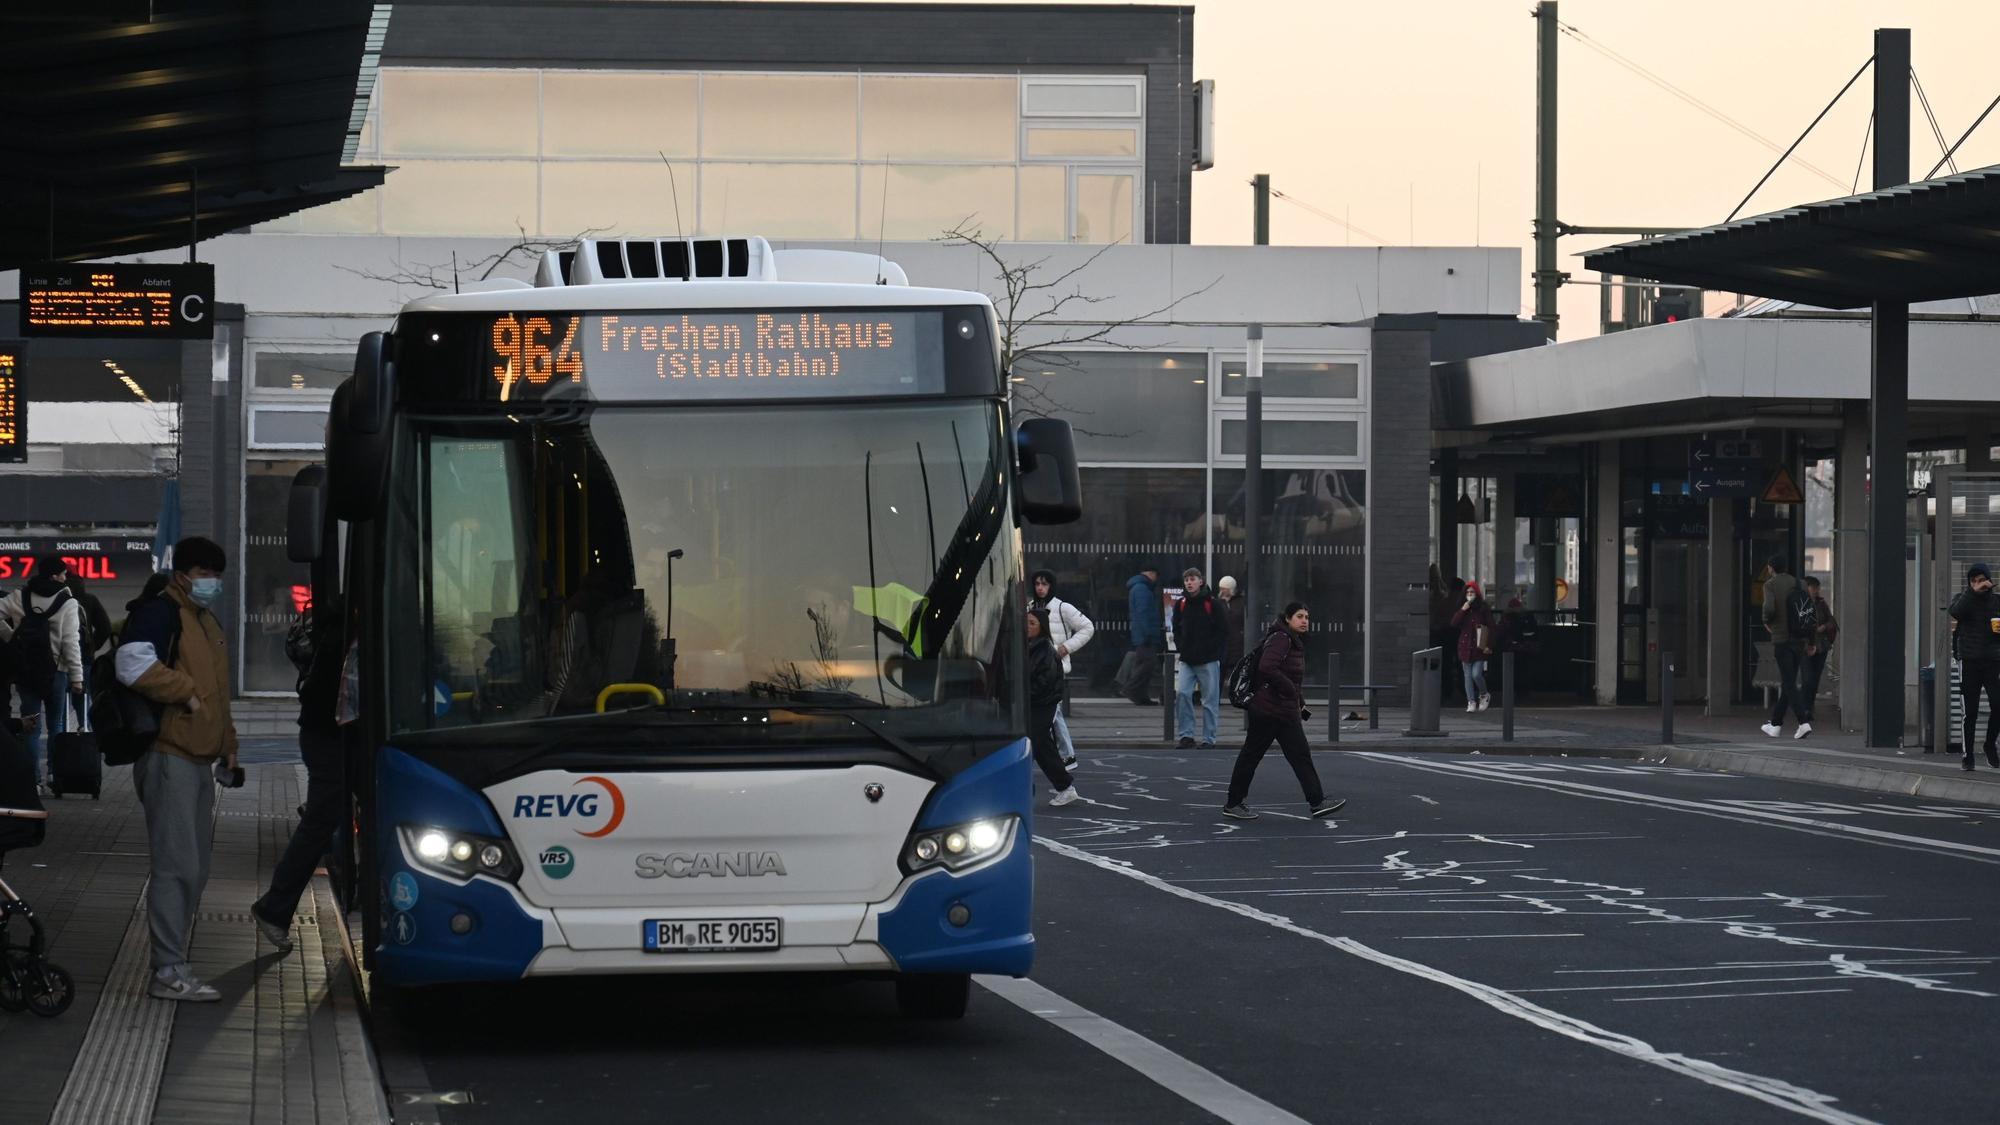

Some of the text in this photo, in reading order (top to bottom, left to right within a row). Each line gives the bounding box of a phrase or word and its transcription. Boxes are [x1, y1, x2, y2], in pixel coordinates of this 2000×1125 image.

[29, 277, 171, 287] Linie Ziel Abfahrt
[180, 294, 204, 323] C
[491, 313, 894, 384] 964 Frechen Rathaus
[655, 351, 840, 379] (Stadtbahn)
[1716, 479, 1745, 489] Ausgang
[1679, 521, 1708, 534] Aufz
[56, 541, 100, 551] SCHNITZEL
[127, 541, 149, 550] PIZZA
[1450, 760, 1746, 778] BUS
[513, 794, 599, 818] REVG
[539, 852, 566, 864] VRS
[634, 850, 787, 878] SCANIA
[659, 923, 684, 945] BM
[698, 923, 723, 944] RE
[728, 922, 777, 944] 9055
